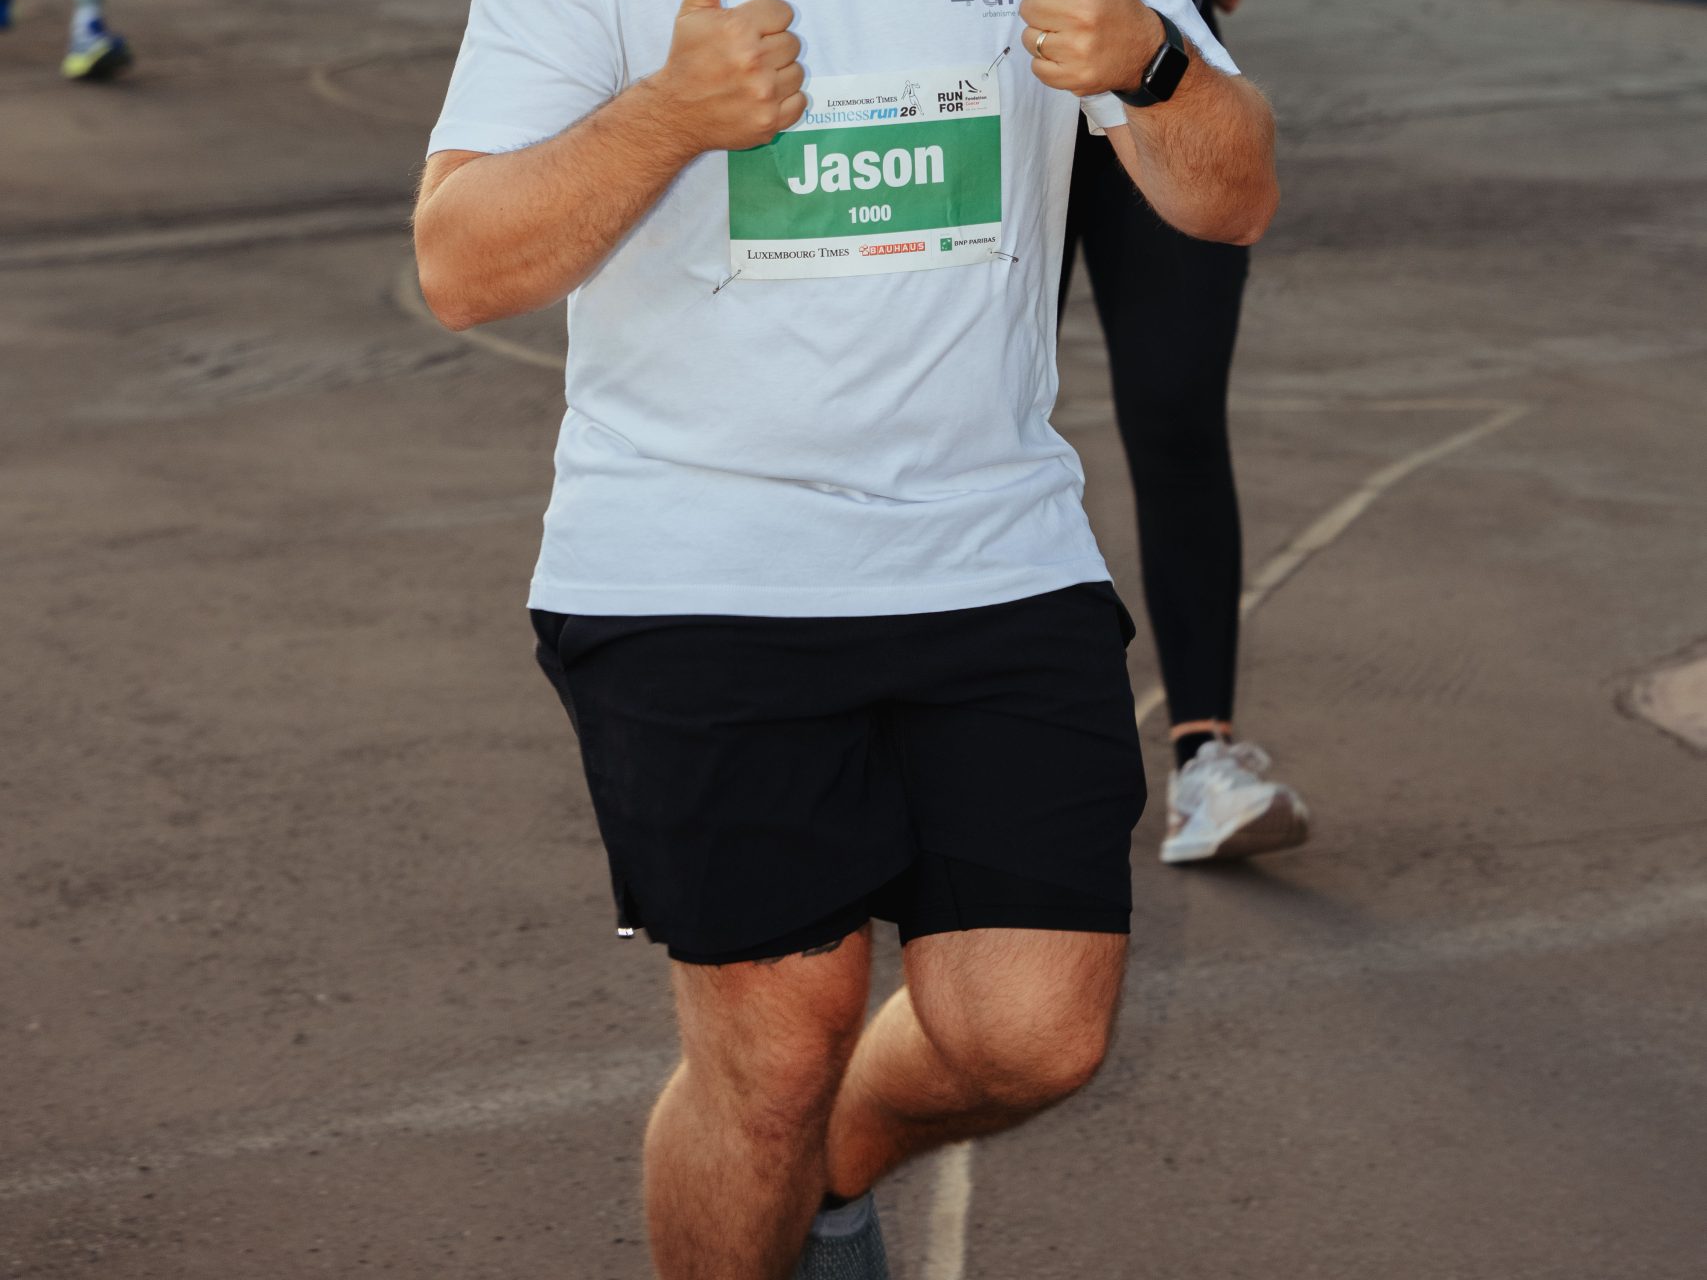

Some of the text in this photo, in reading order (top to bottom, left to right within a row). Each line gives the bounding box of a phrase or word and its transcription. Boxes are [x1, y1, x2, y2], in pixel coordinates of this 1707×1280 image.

[982, 9, 1016, 18] urbanisme
[937, 91, 963, 102] RUN
[900, 106, 917, 118] 26
[939, 102, 964, 113] FOR
[787, 143, 945, 195] Jason
[848, 204, 892, 224] 1000
[968, 236, 996, 246] PARIBAS
[747, 247, 850, 260] LUXEMBOURG TIMES
[869, 241, 925, 256] BAUHAUS
